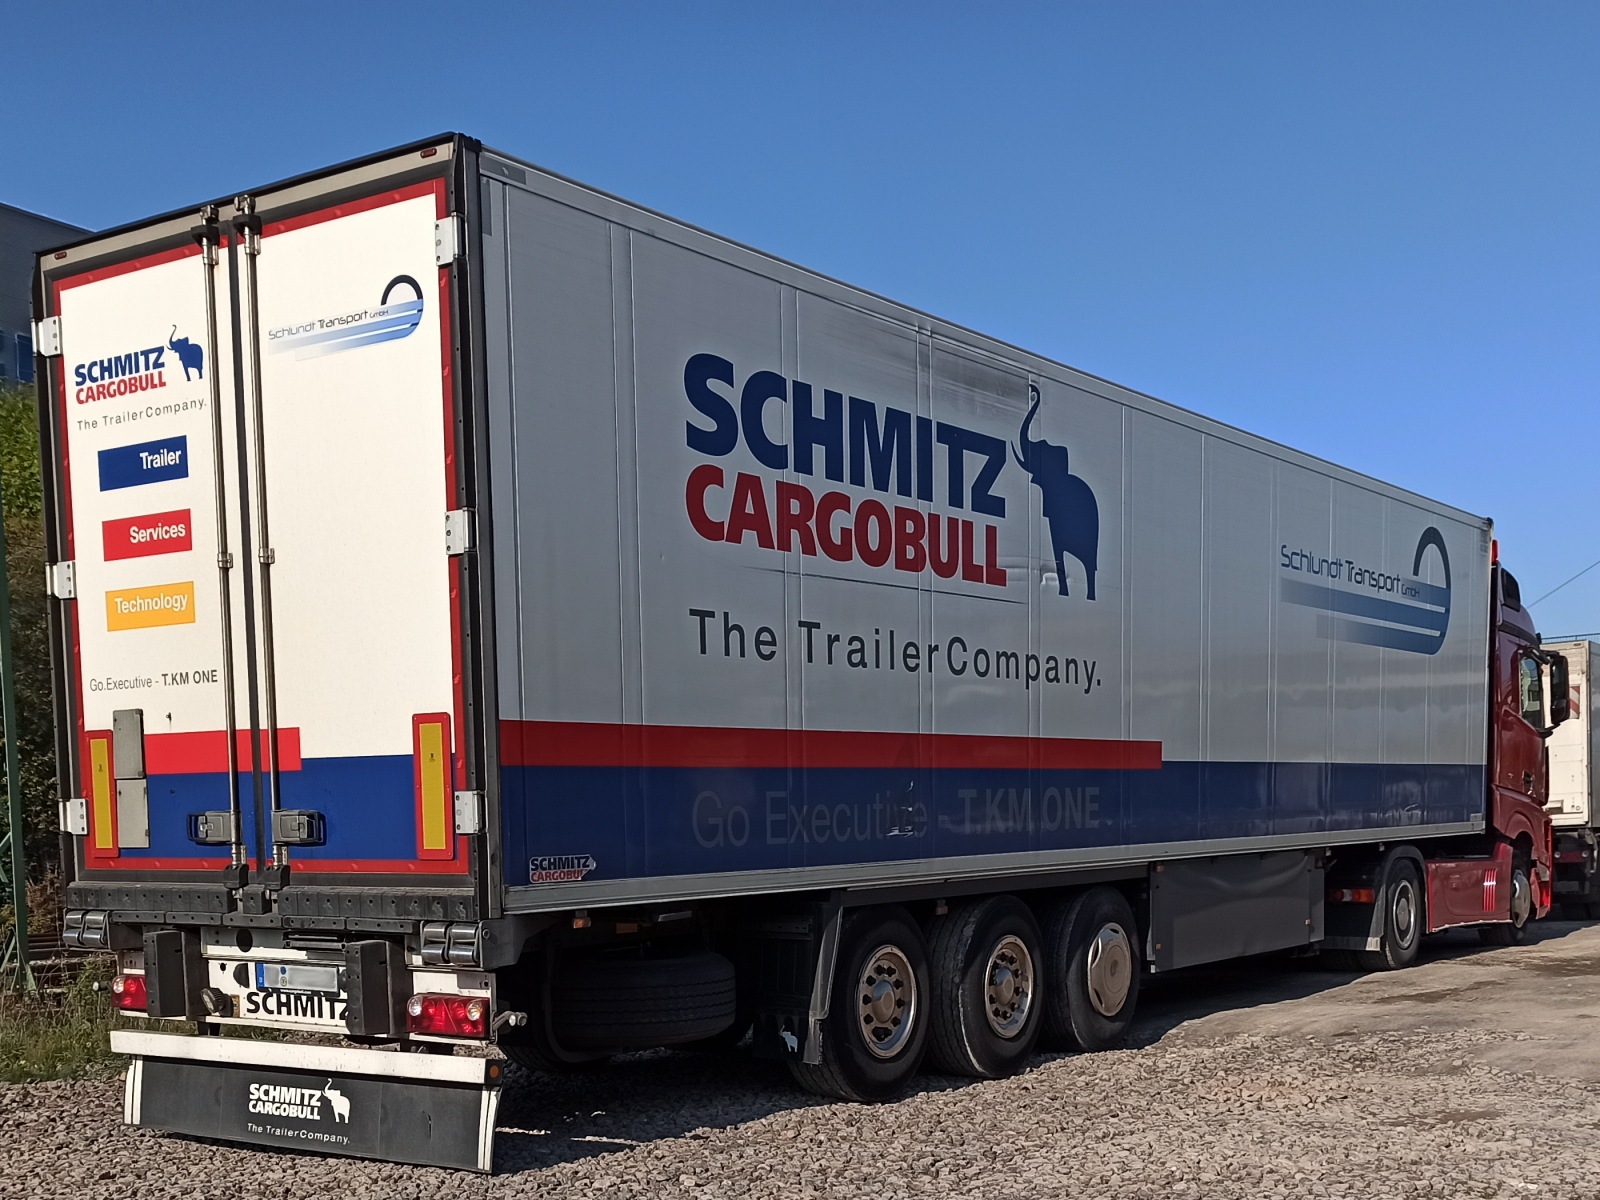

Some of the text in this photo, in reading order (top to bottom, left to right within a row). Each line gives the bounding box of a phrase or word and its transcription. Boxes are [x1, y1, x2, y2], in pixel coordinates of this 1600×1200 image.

[268, 322, 316, 340] Schlundt
[317, 309, 368, 329] Transport
[74, 345, 165, 387] SCHMITZ
[75, 370, 167, 405] CARGOBULL
[77, 420, 98, 431] The
[683, 352, 1007, 519] SCHMITZ
[139, 448, 182, 470] Trailer
[129, 522, 186, 544] Services
[685, 463, 1007, 588] CARGOBULL
[1280, 544, 1343, 579] Schlundt
[1345, 559, 1401, 593] Transport
[114, 593, 188, 614] Technology
[689, 608, 778, 661] The
[161, 671, 190, 687] T.KM
[192, 669, 218, 685] ONE
[692, 789, 751, 848] Go
[765, 789, 929, 845] Executive
[957, 787, 1032, 835] T.KM
[1042, 786, 1100, 832] ONE
[530, 856, 590, 872] SCHMITZ
[249, 1083, 322, 1107] SCHMITZ
[248, 1100, 321, 1121] CARGOBULL
[247, 1123, 263, 1133] The
